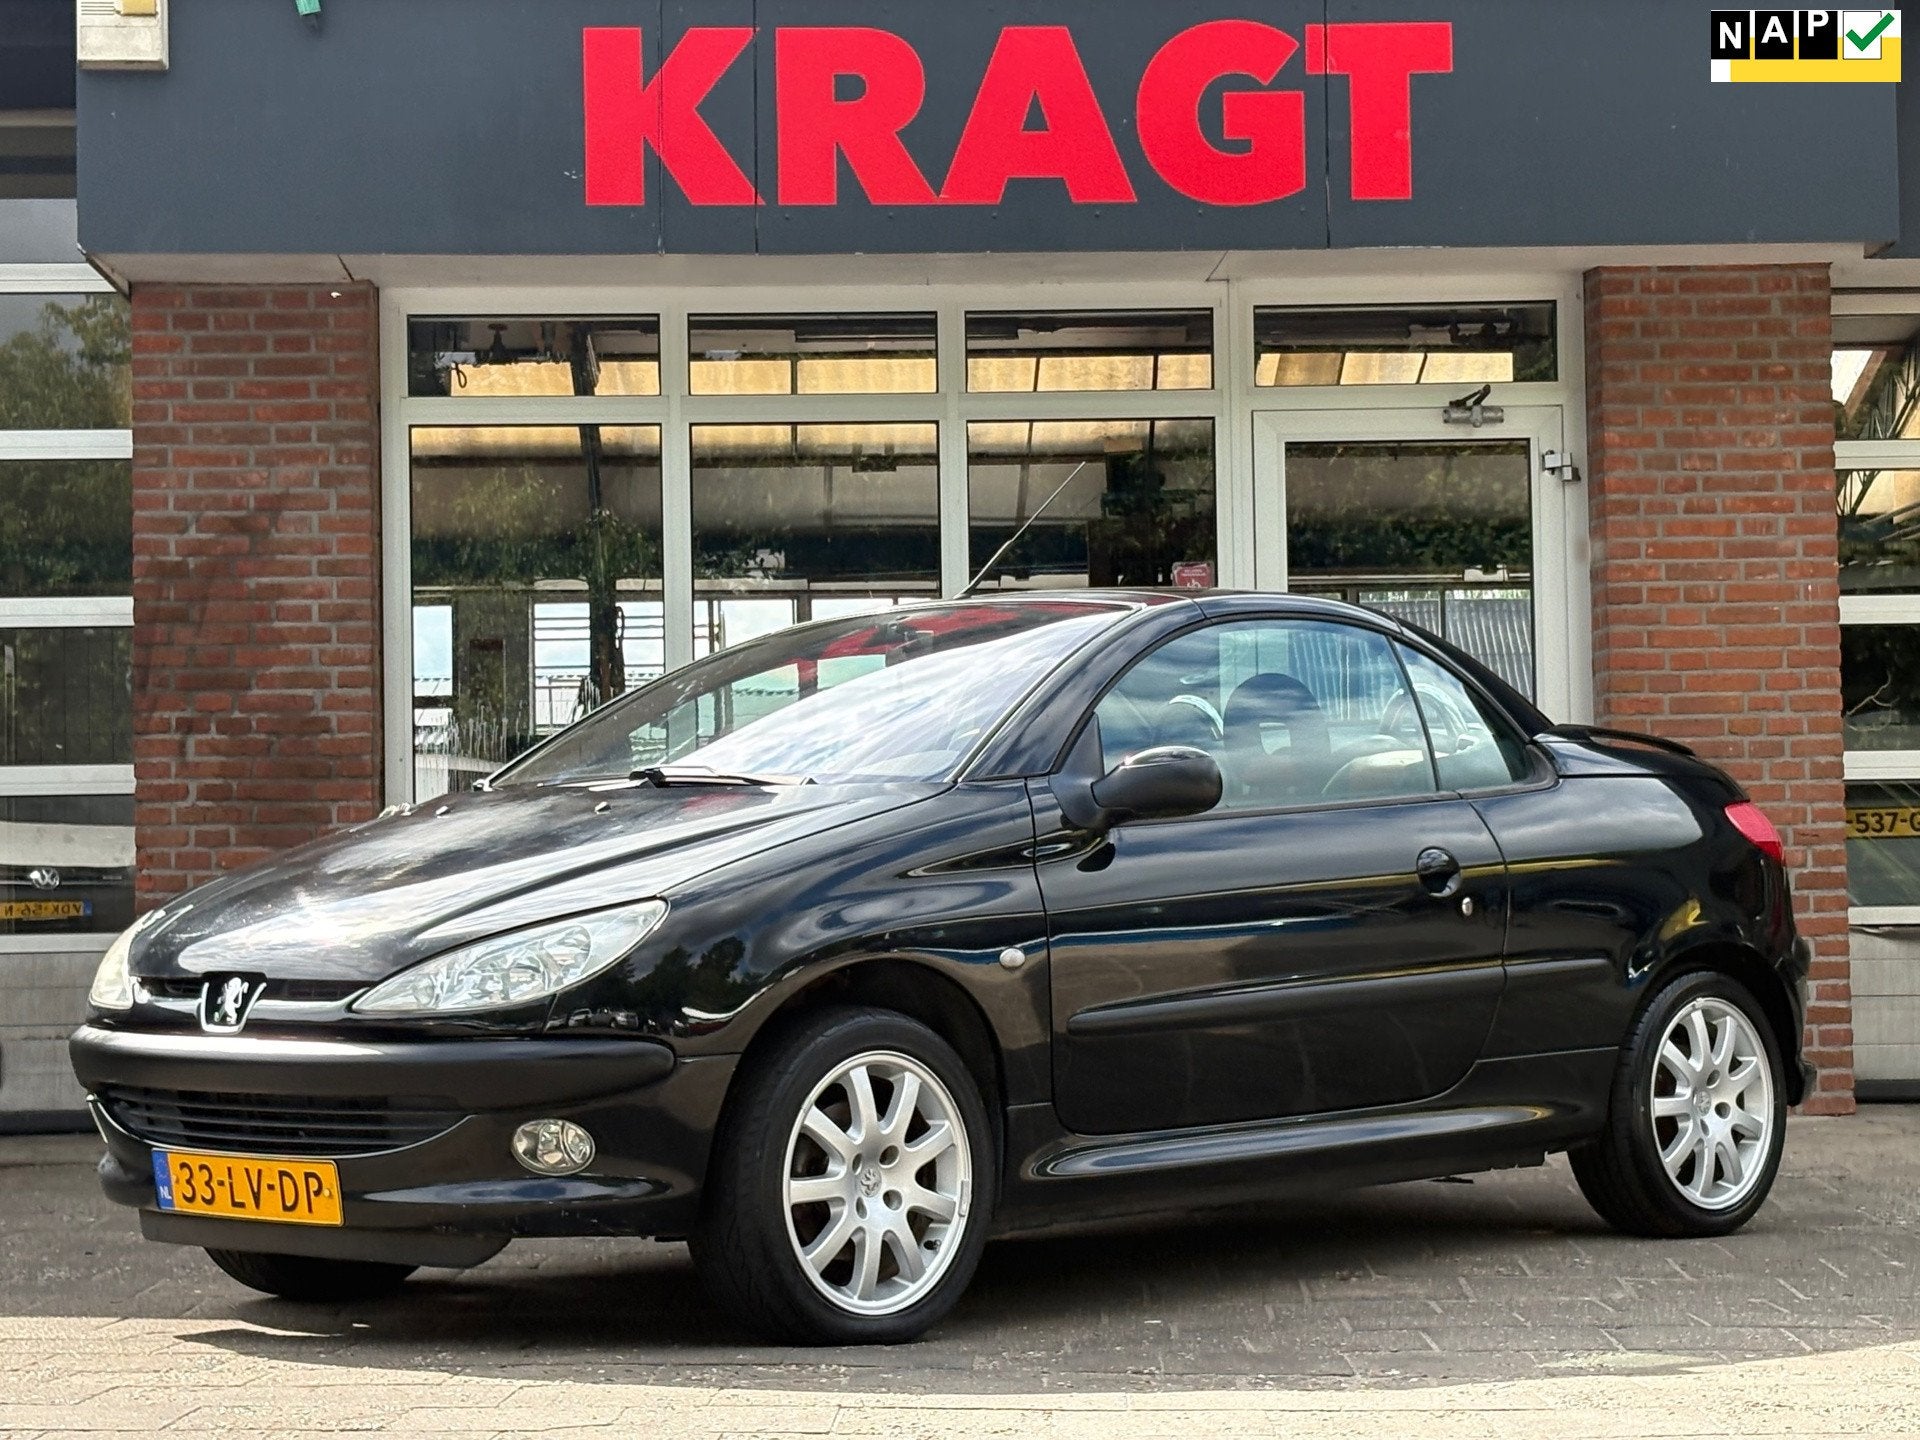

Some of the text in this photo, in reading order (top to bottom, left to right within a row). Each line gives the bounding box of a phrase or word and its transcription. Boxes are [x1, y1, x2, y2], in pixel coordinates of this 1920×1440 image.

[582, 19, 1455, 206] KRAGT
[159, 1185, 172, 1200] NL
[179, 1161, 324, 1214] 33-LV-DP
